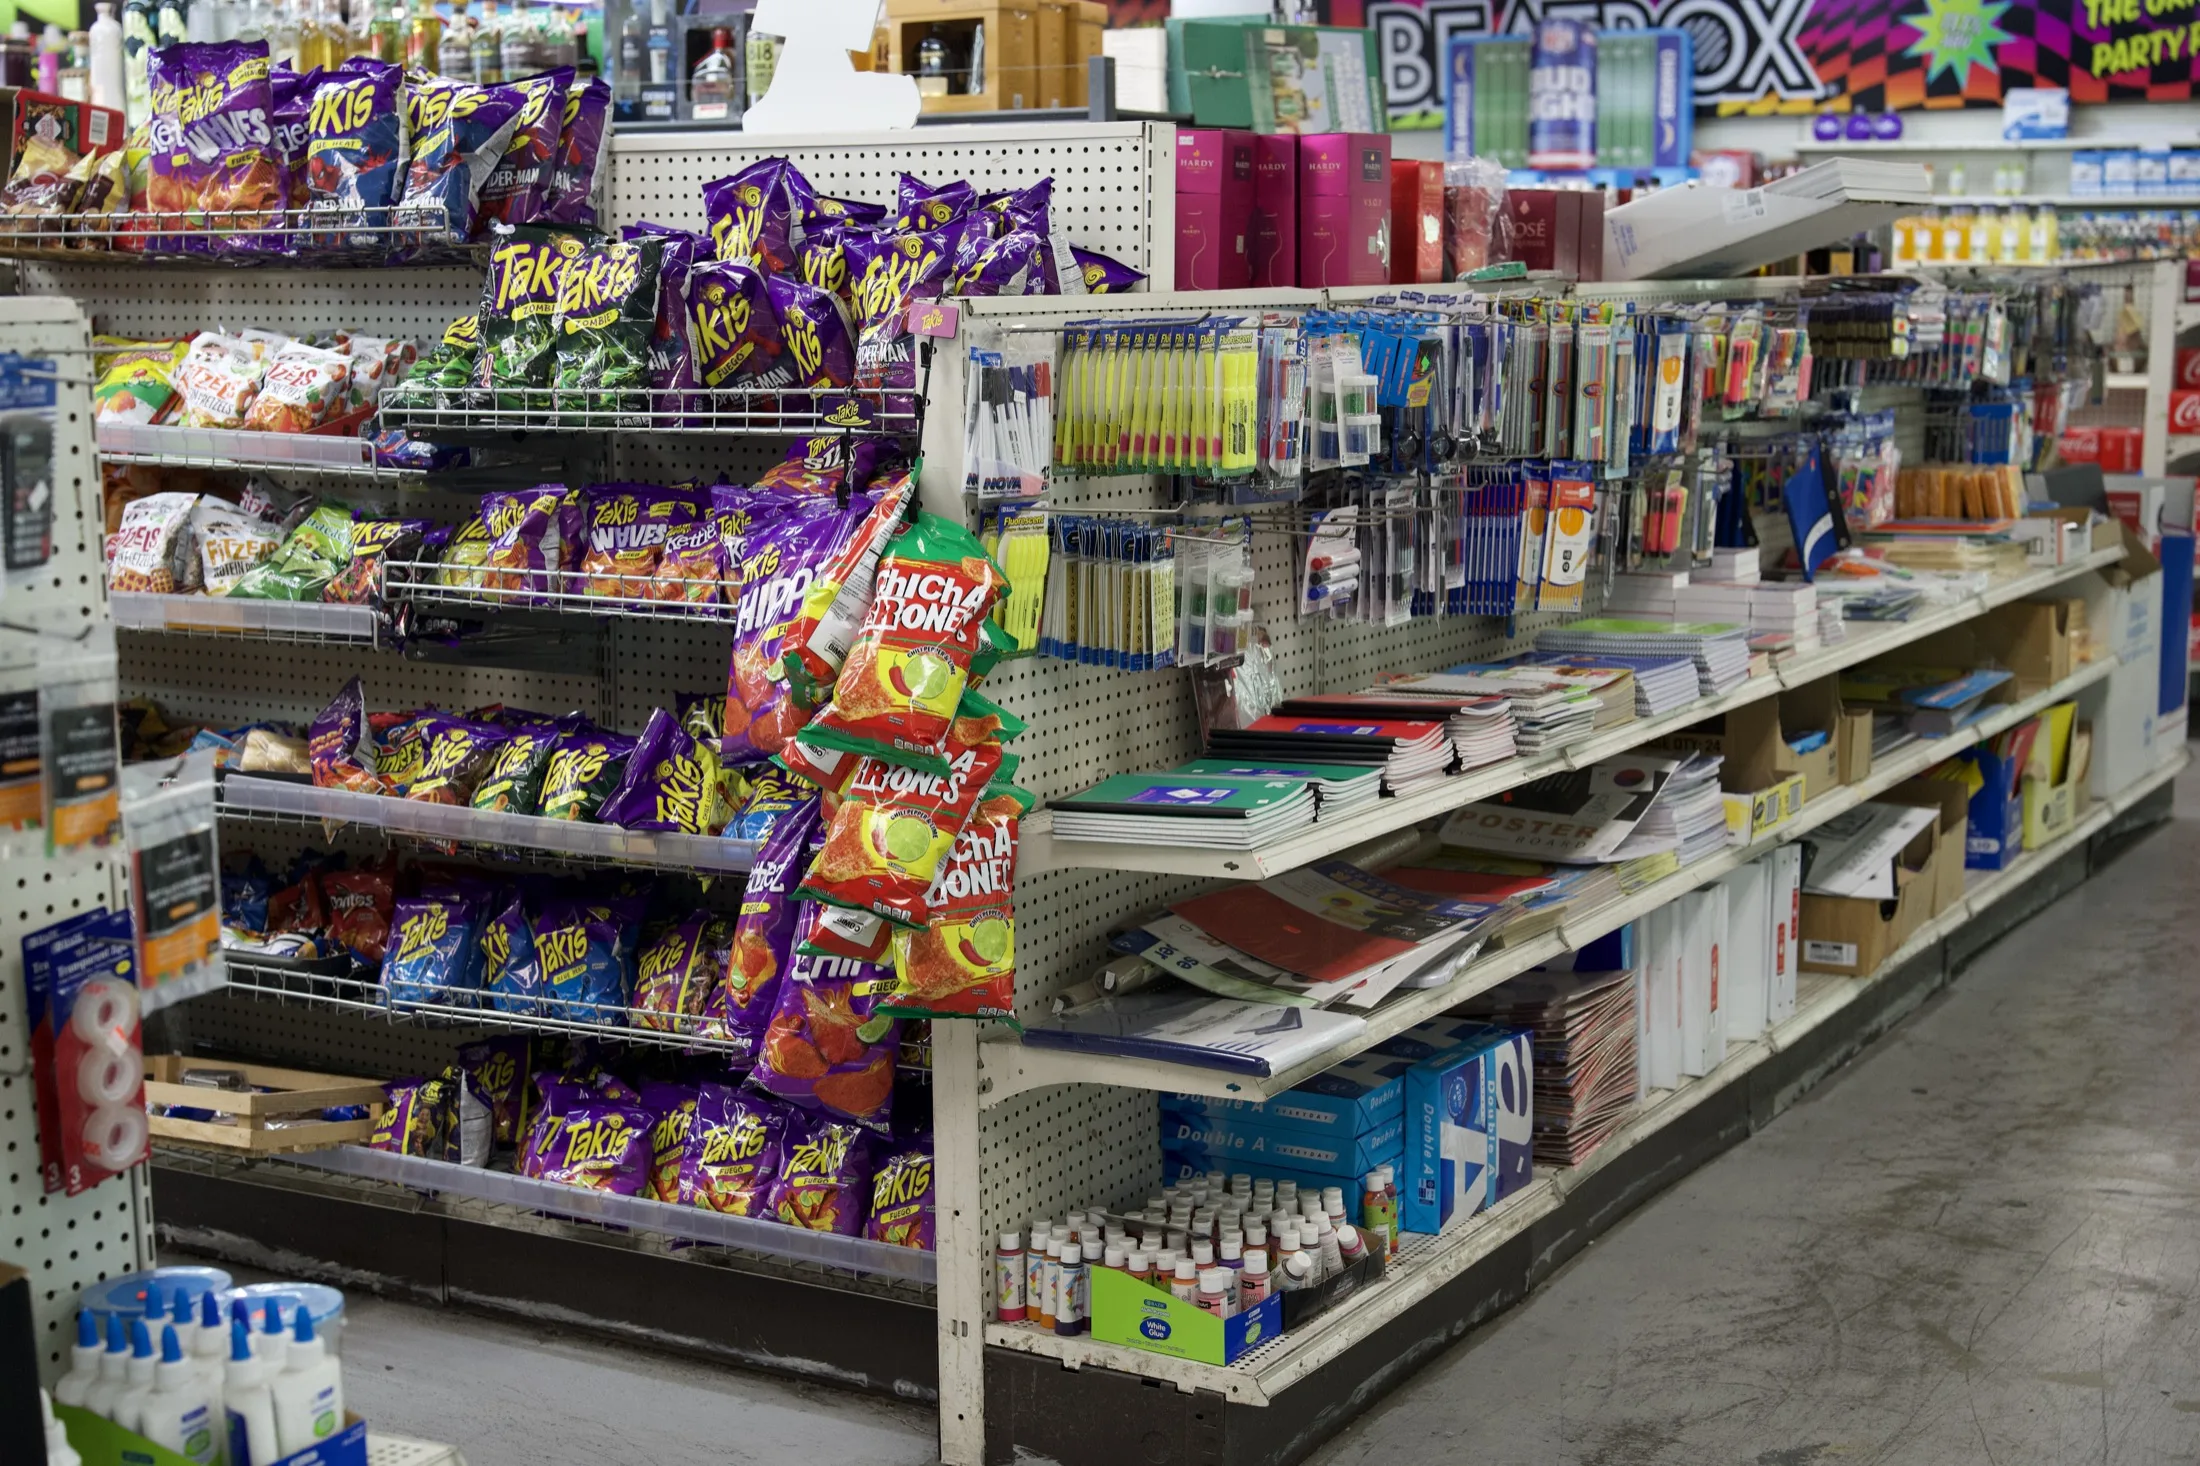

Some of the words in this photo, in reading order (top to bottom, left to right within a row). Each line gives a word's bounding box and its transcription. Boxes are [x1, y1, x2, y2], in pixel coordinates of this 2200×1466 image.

[2092, 26, 2186, 78] PARTY
[177, 83, 226, 131] Takis
[184, 107, 272, 166] WAVES
[1180, 159, 1214, 167] HARDY
[1309, 162, 1341, 170] HARDY
[575, 313, 613, 329] ZOMBIE
[921, 311, 944, 333] Takis
[1219, 332, 1254, 345] Fluorescent
[716, 351, 746, 380] FUEGO
[835, 402, 859, 422] Takis
[983, 475, 1022, 491] NOVA
[592, 499, 640, 528] Takis
[1003, 513, 1046, 527] Fluorescent
[589, 523, 669, 554] WAVES
[1673, 737, 1698, 751] QTY
[1705, 738, 1722, 752] 24
[537, 748, 612, 806] Takis
[654, 754, 703, 834] Takis
[906, 809, 929, 823] PEPPER
[930, 822, 939, 840] LIME
[1455, 809, 1599, 839] POSTER
[1515, 835, 1588, 849] BOARD
[837, 916, 863, 932] BIMBO
[395, 909, 450, 962] Takis
[534, 927, 588, 982] Takis
[637, 941, 688, 991] Takis
[1251, 1099, 1265, 1113] A
[1370, 1088, 1395, 1109] Double
[1275, 1108, 1330, 1121] EVERYDAY
[1487, 1080, 1496, 1154] Double
[1176, 1124, 1245, 1149] Double
[1252, 1136, 1265, 1151] A
[1371, 1129, 1396, 1149] Double
[1423, 1103, 1435, 1159] Double
[561, 1117, 634, 1170] Takis
[698, 1125, 768, 1172] Takis
[1275, 1146, 1331, 1160] EVERYDAY
[782, 1135, 850, 1181] Takis
[71, 1165, 81, 1184] 3
[718, 1165, 744, 1176] FUEGO
[1423, 1163, 1435, 1176] A
[1487, 1163, 1496, 1176] A
[803, 1176, 829, 1186] FUEGO
[871, 1162, 932, 1219] Takis
[889, 1207, 912, 1221] FUEGO
[1146, 1321, 1167, 1332] White
[1148, 1327, 1165, 1338] Glue
